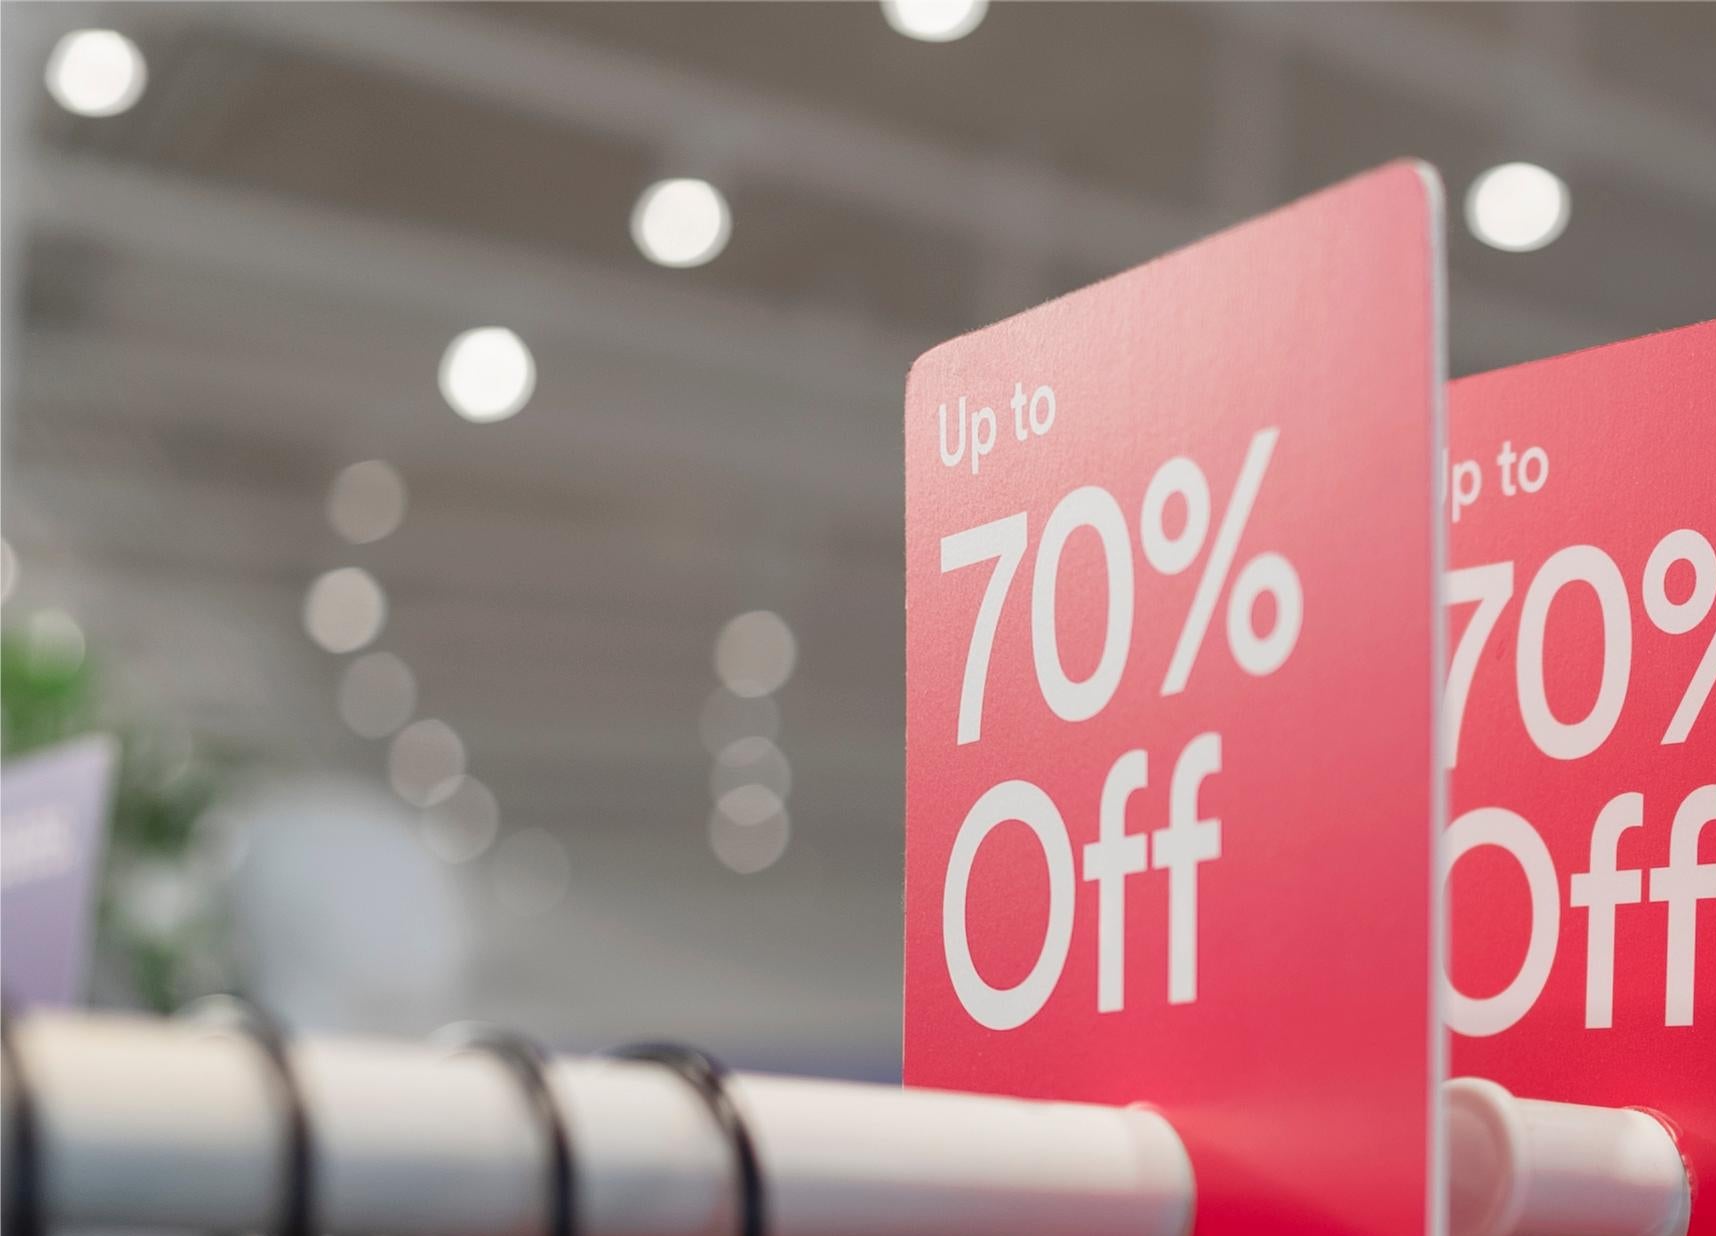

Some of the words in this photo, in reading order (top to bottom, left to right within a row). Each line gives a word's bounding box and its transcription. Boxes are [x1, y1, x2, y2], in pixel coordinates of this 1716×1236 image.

[938, 394, 998, 474] Up
[1010, 382, 1057, 439] to
[1495, 439, 1550, 497] to
[940, 425, 1305, 747] 70%
[942, 730, 1223, 1031] Off
